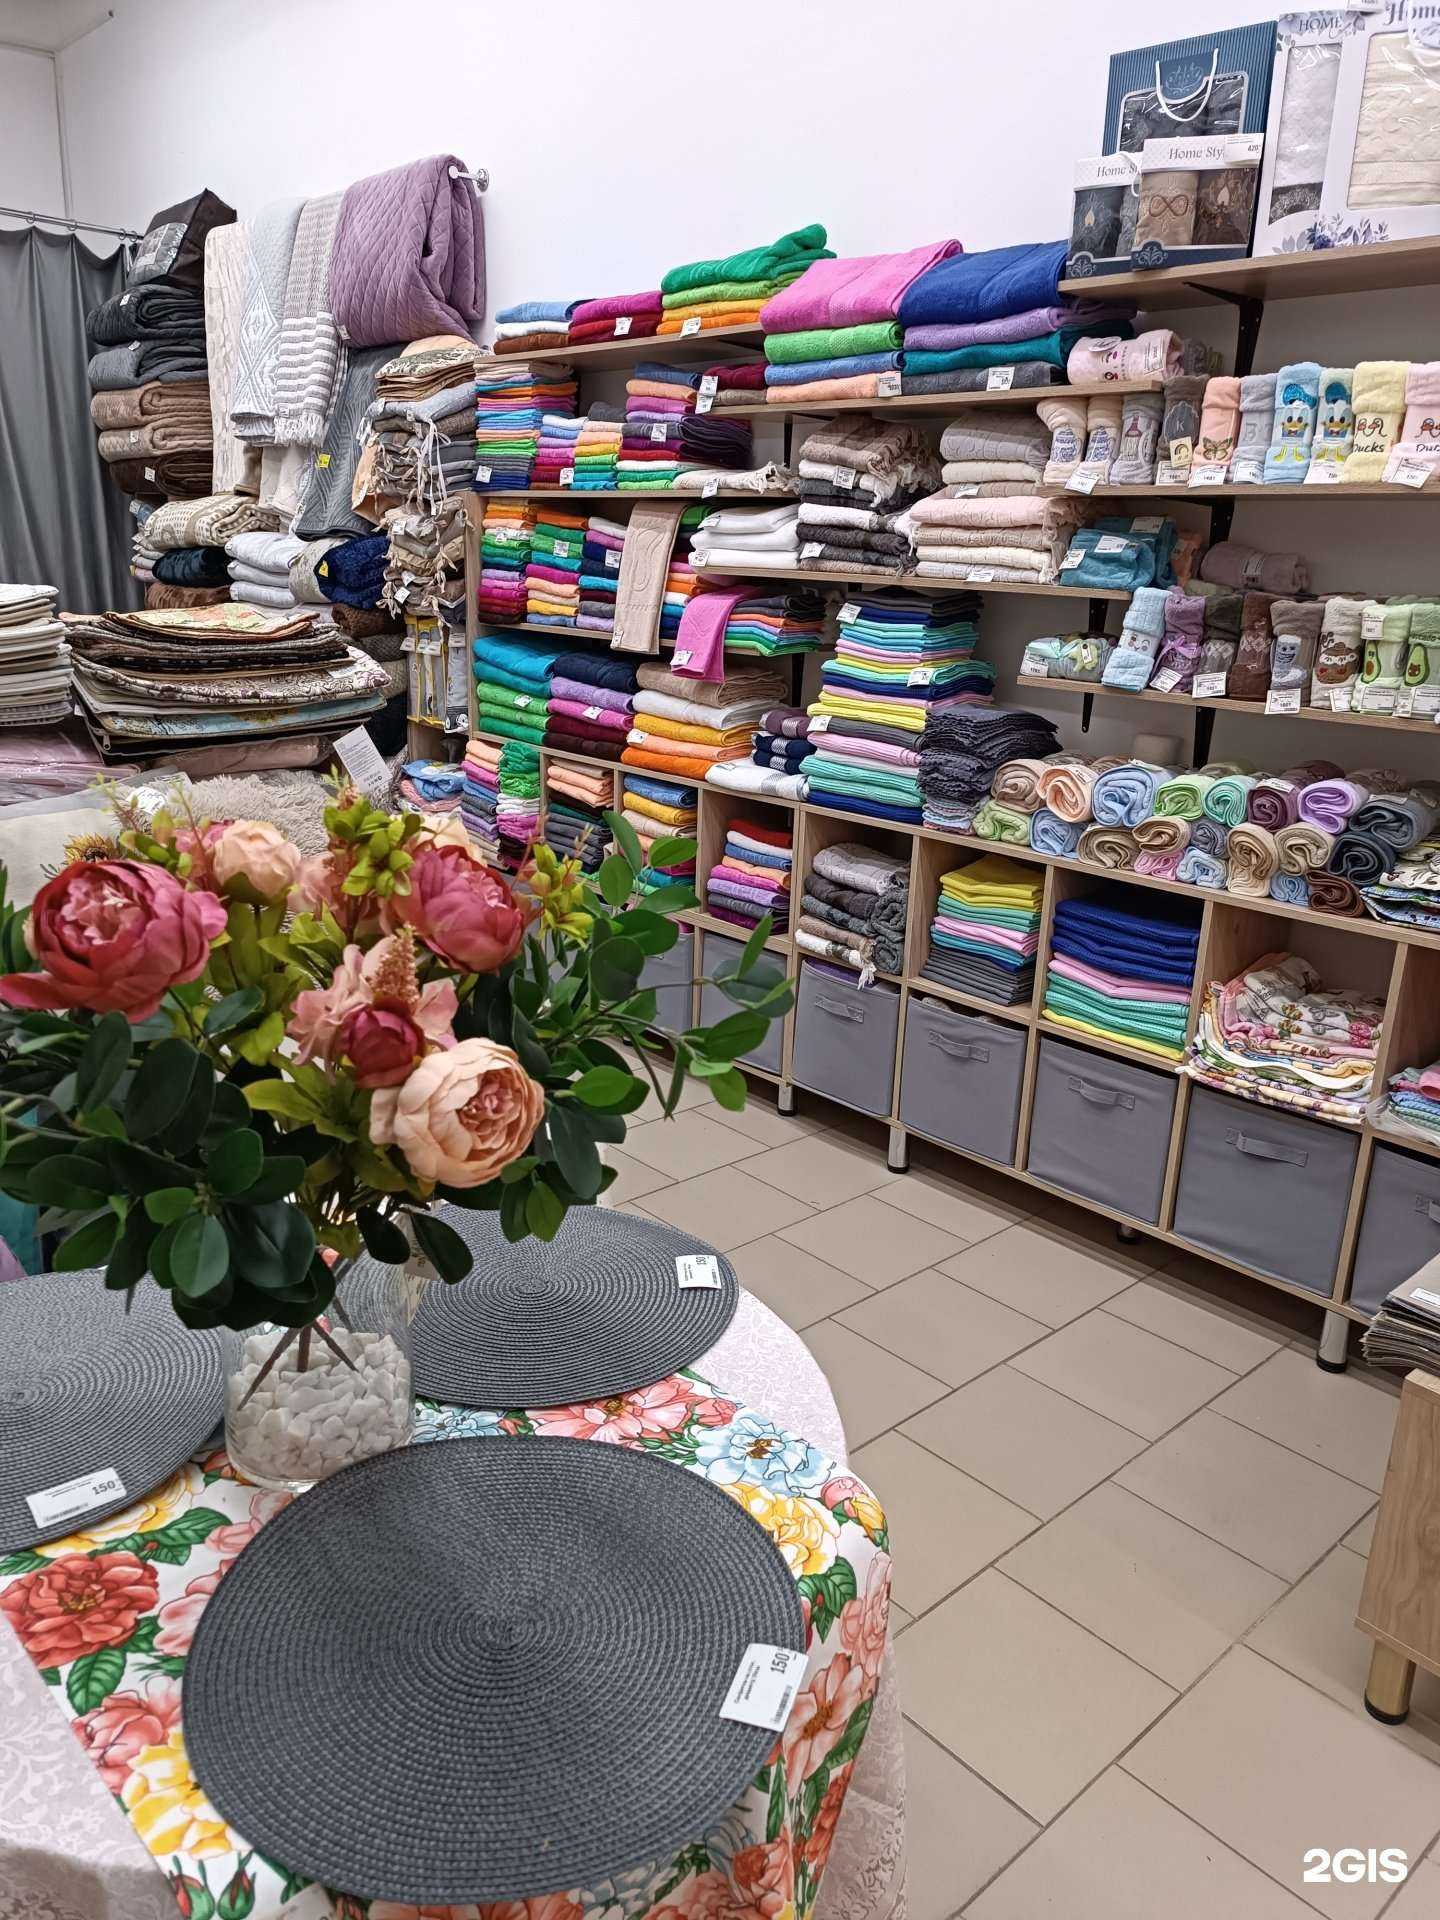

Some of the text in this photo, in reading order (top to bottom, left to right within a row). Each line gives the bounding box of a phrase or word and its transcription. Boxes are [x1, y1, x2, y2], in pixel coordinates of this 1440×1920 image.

[1299, 15, 1342, 31] HOME
[1168, 146, 1224, 160] Home Sty
[1096, 165, 1126, 177] Home
[92, 1480, 116, 1496] 150
[770, 1652, 790, 1674] 150
